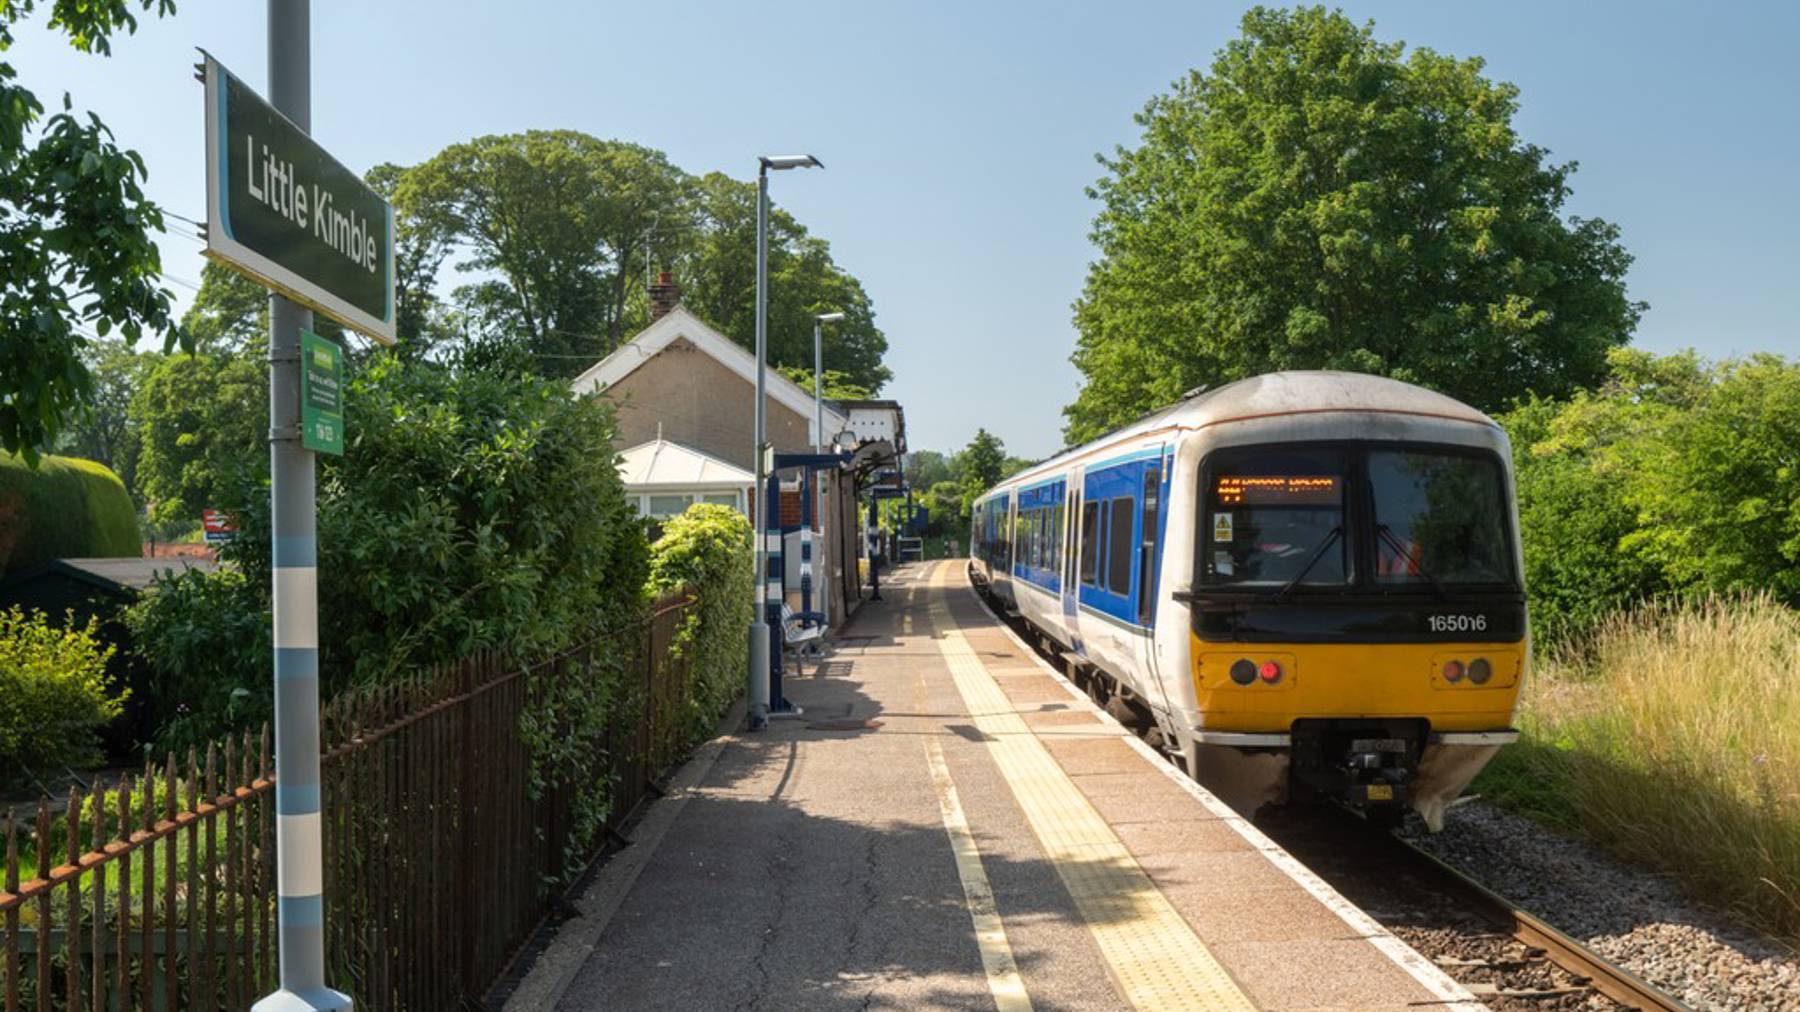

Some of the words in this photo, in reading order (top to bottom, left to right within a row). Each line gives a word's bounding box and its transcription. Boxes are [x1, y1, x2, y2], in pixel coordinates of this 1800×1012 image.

[248, 134, 308, 229] Little
[314, 183, 377, 274] Kimble
[1428, 614, 1487, 632] 165016
